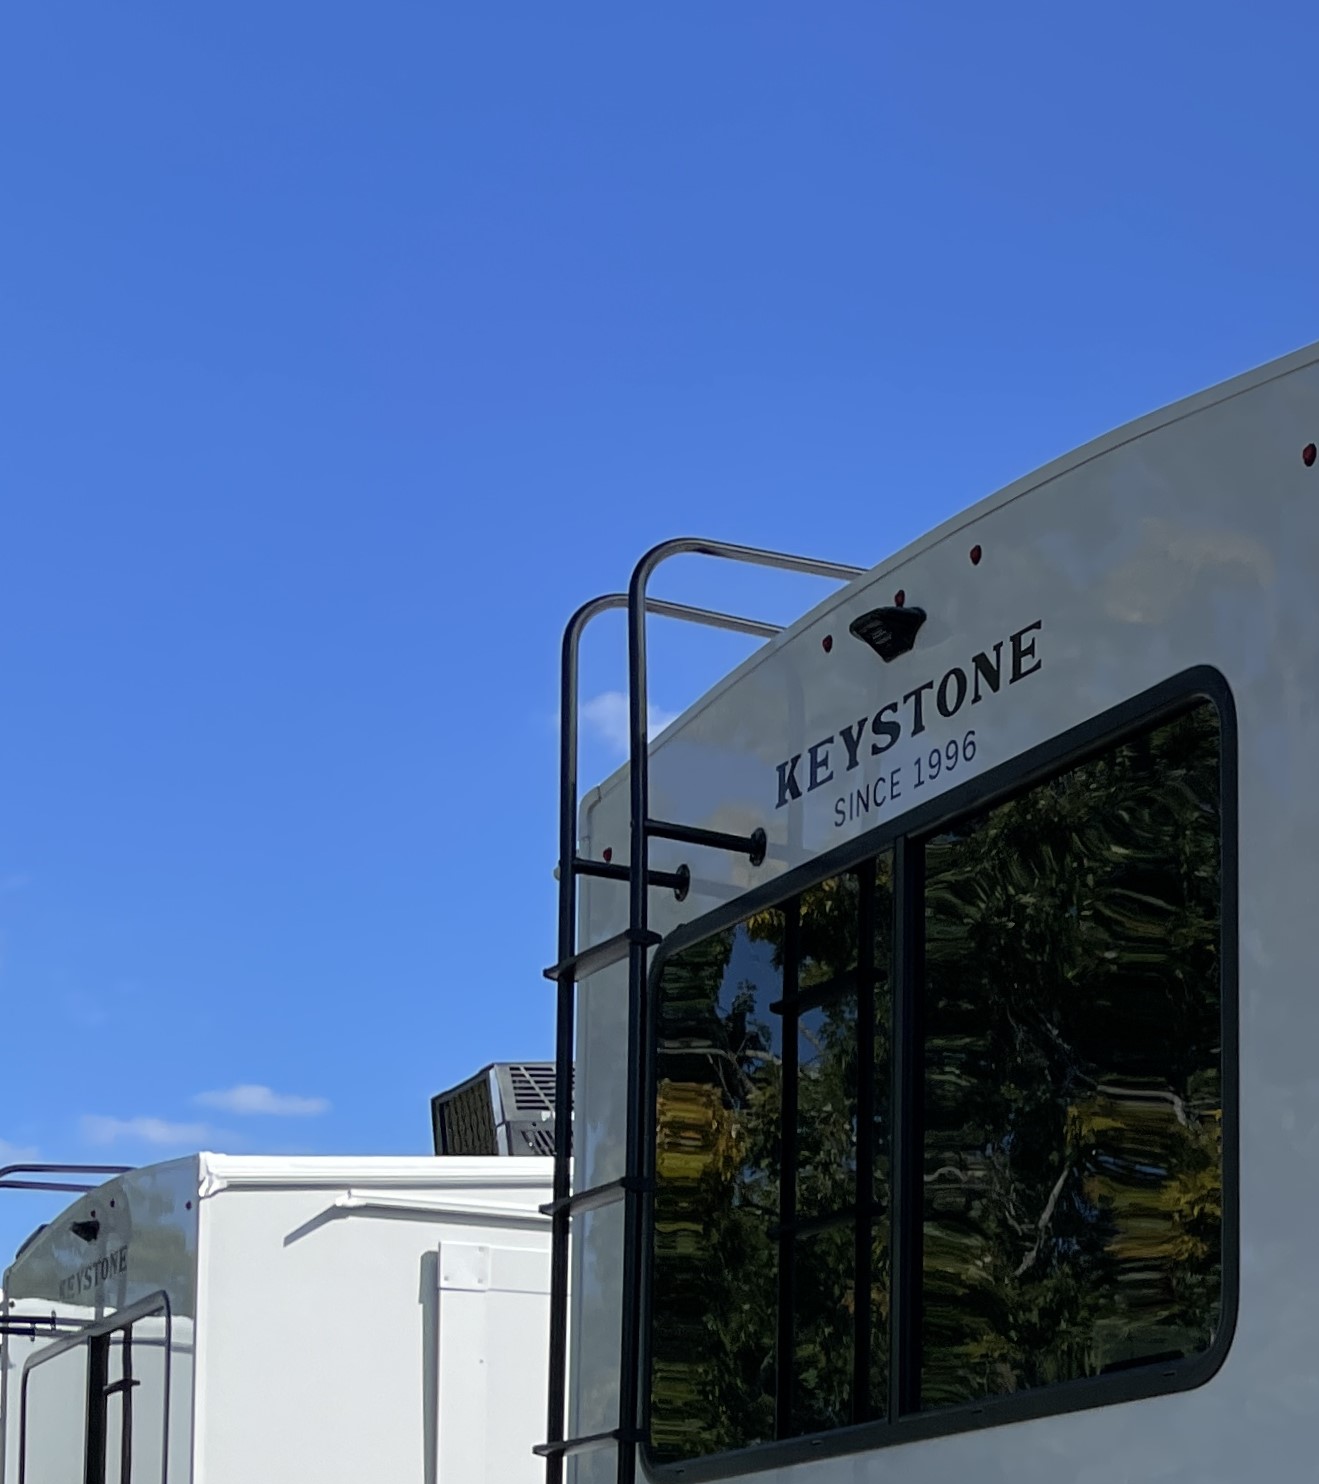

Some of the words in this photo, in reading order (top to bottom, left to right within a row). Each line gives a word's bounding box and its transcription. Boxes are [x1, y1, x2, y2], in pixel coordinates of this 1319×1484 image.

[775, 620, 1042, 809] KEYSTONE
[833, 767, 903, 829] SINCE
[913, 730, 978, 790] 1996
[58, 1244, 128, 1300] KEYSTONE
